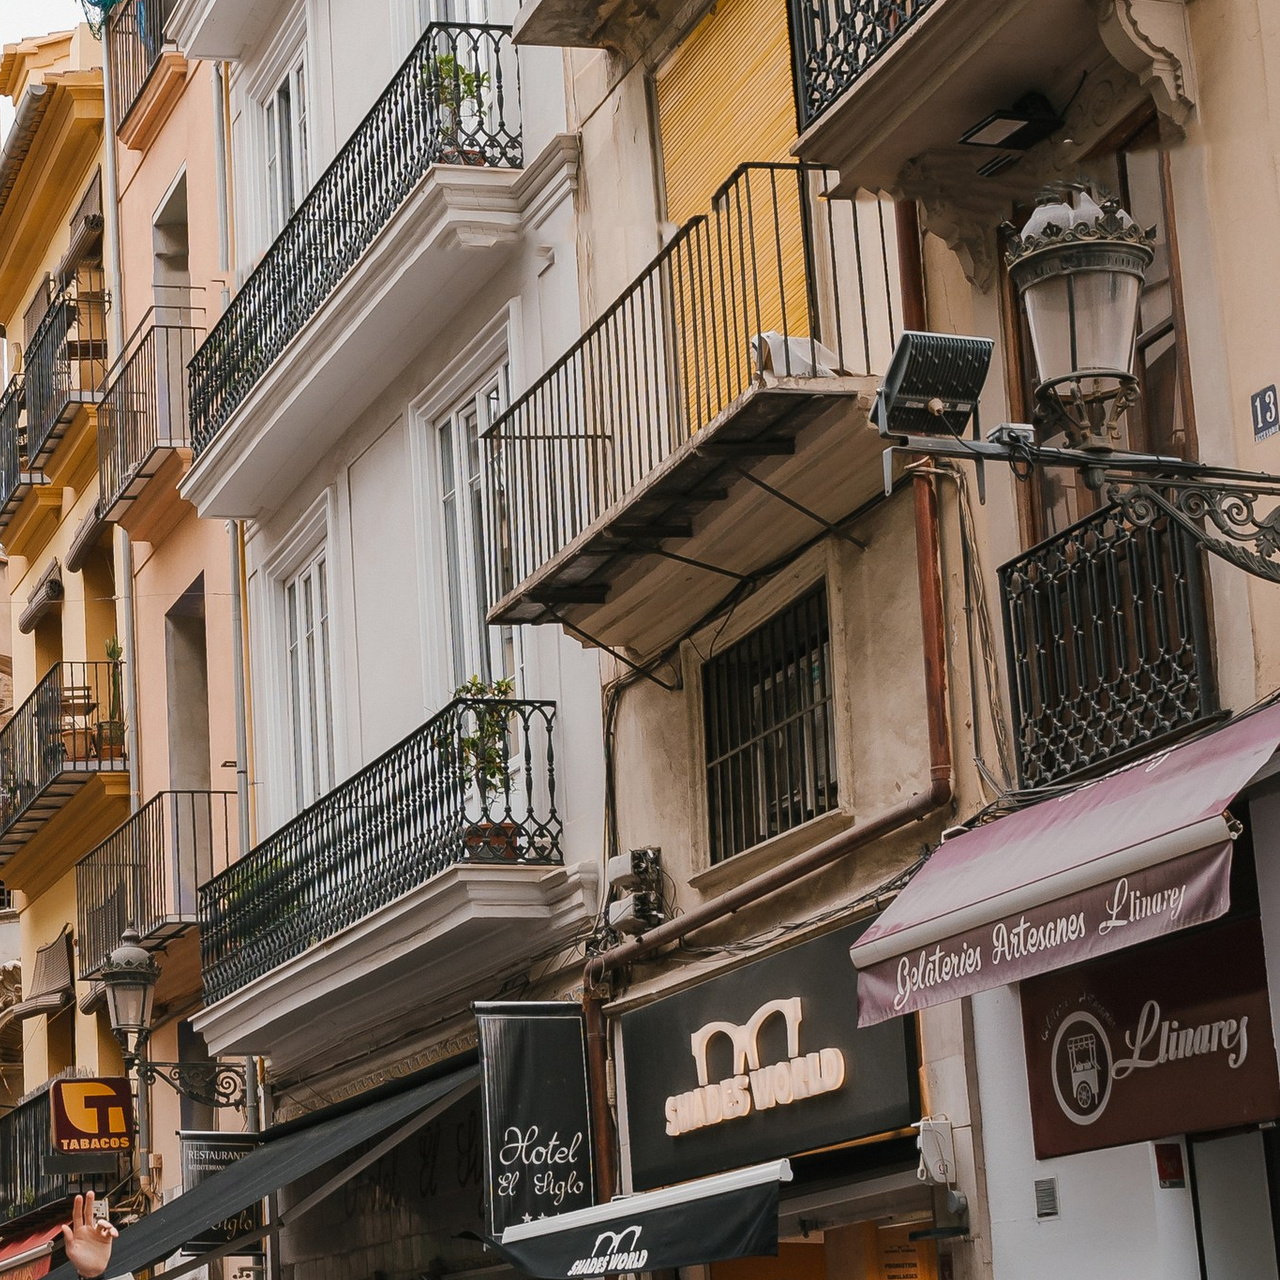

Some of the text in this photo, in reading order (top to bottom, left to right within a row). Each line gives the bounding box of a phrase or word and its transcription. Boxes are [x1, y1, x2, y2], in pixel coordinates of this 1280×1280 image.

[1255, 391, 1276, 428] 13
[894, 878, 1187, 1011] Gelateries Artesanes Llinares
[1111, 1000, 1249, 1080] Llinares
[665, 1047, 845, 1137] SHADES WORLD
[61, 1137, 130, 1150] TABACOS
[500, 1125, 582, 1165] Hotel
[498, 1171, 584, 1205] El Siglo
[567, 1249, 648, 1276] SHADES WORLD
